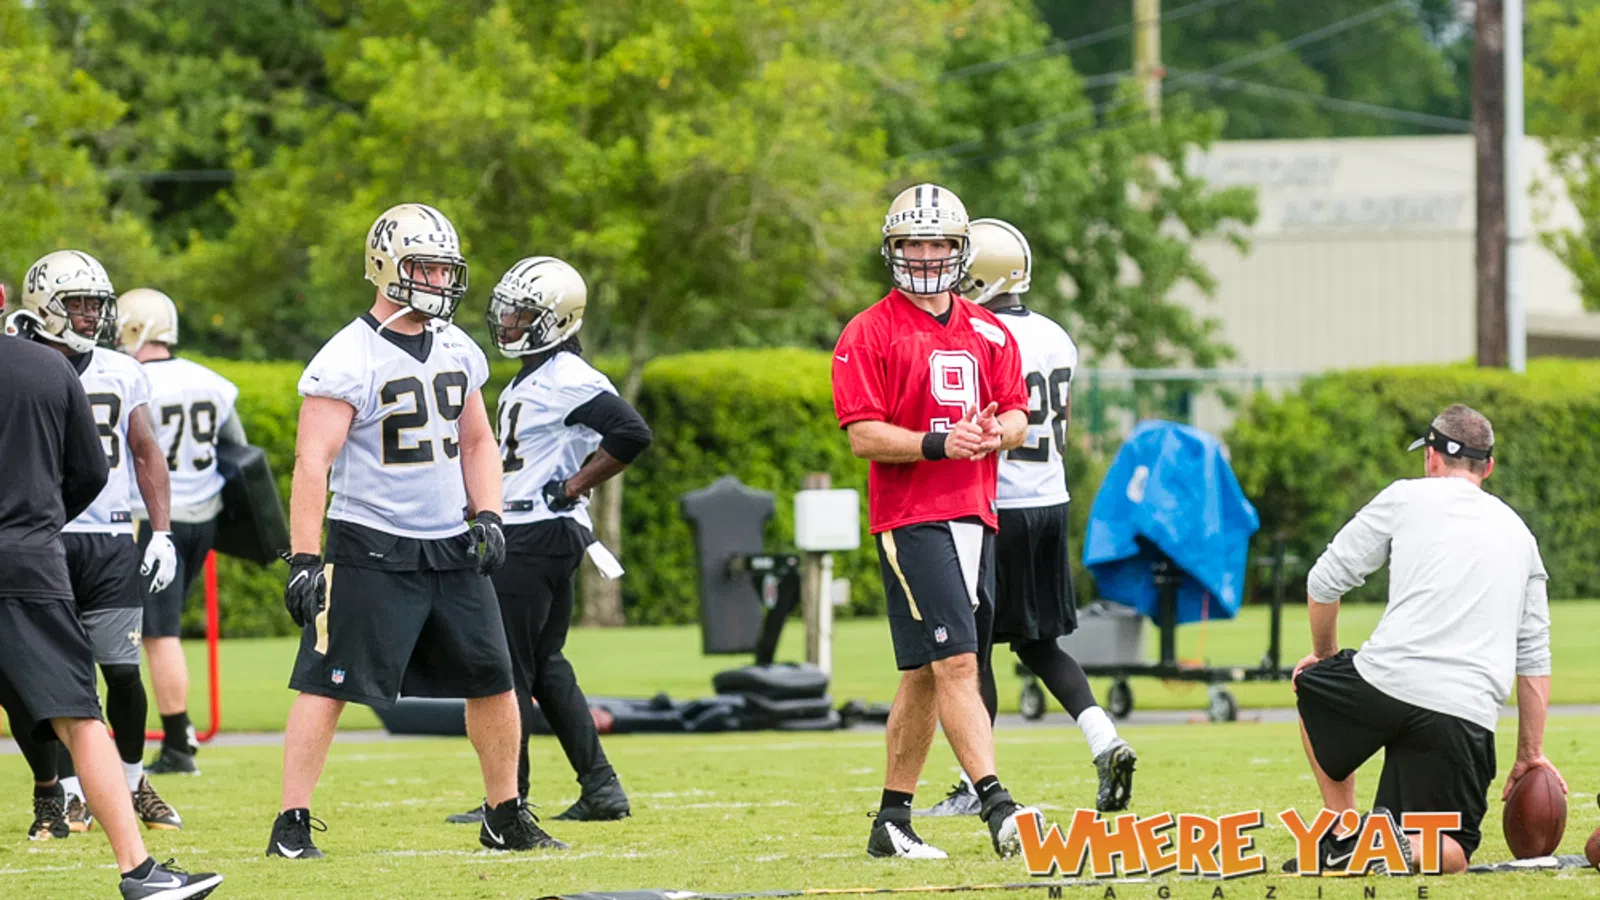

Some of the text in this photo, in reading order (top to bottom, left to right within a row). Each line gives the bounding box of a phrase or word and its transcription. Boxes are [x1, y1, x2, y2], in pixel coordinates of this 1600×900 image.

[889, 208, 961, 227] BREES
[28, 263, 48, 294] 96
[379, 370, 468, 466] 29
[929, 349, 980, 433] 9
[1007, 367, 1071, 463] 28
[161, 401, 217, 472] 79
